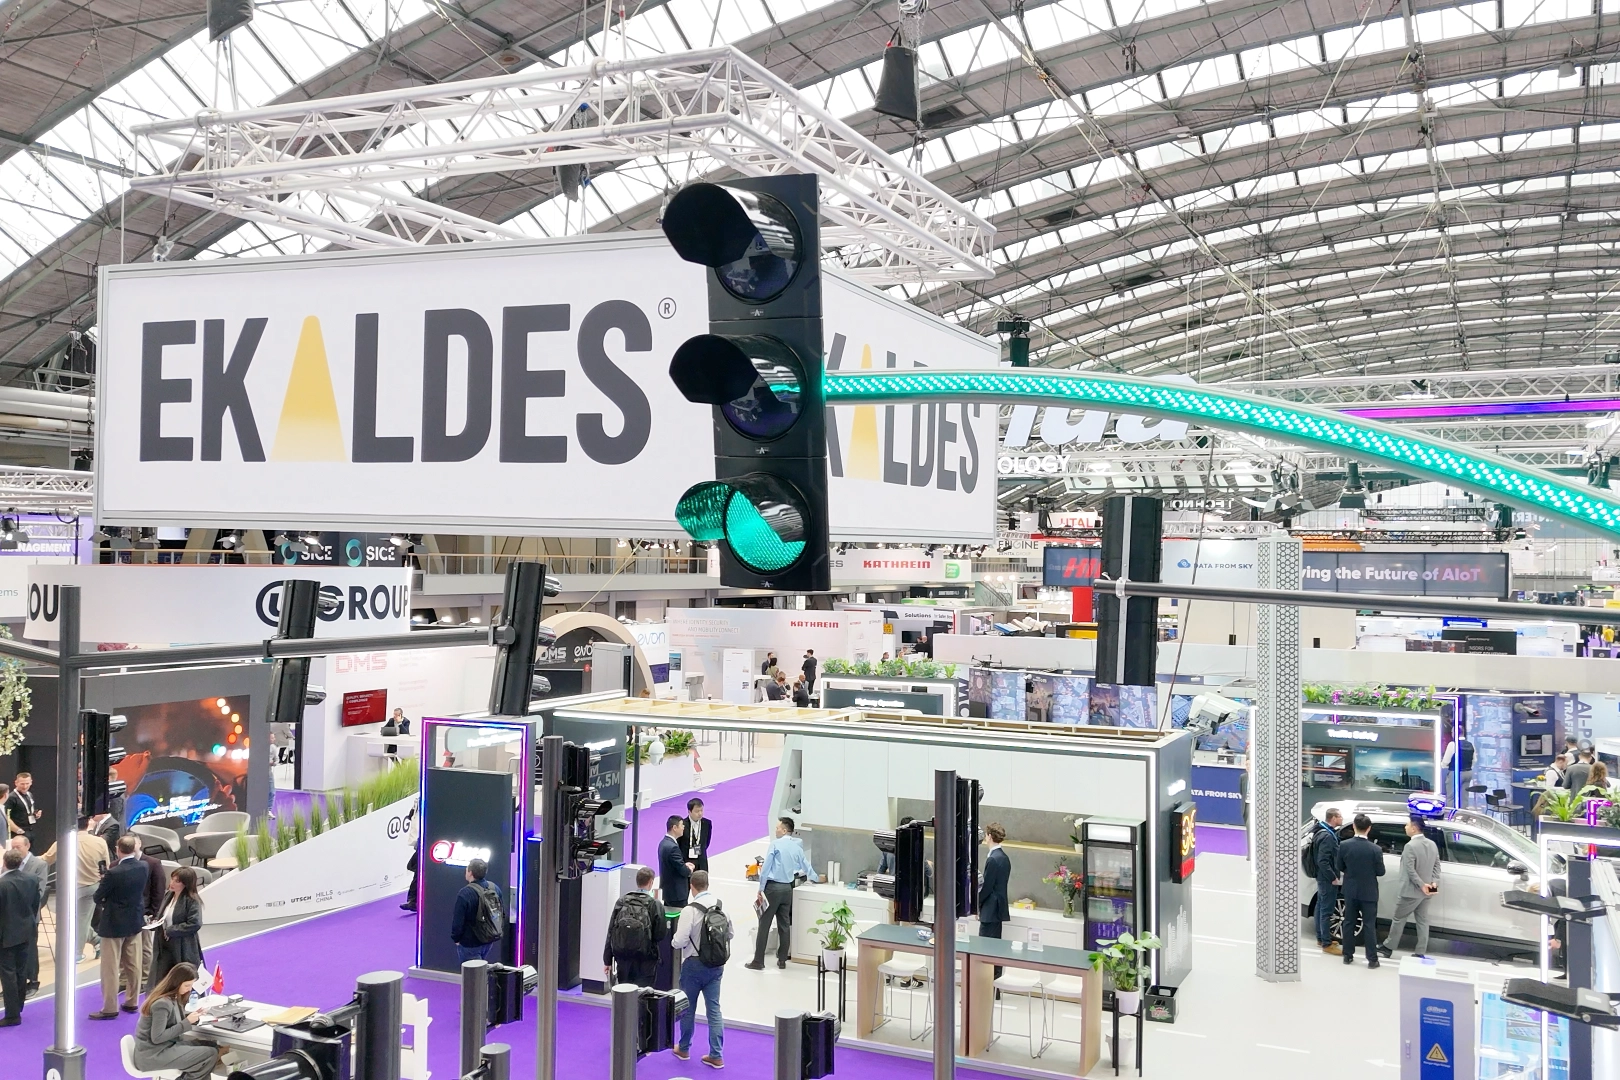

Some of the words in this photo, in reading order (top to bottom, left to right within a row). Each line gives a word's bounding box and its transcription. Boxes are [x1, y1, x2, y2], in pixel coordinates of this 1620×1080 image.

[365, 545, 396, 561] SICE
[863, 560, 931, 569] KATHREIN
[1334, 566, 1361, 580] the
[1365, 566, 1418, 581] Future
[1422, 567, 1439, 581] of
[790, 620, 839, 629] KATHREIN
[637, 631, 666, 646] evon
[335, 652, 388, 674] DMS
[1564, 699, 1574, 740] TRAFFI
[1190, 789, 1203, 798] ATA
[1204, 790, 1227, 798] FROM
[290, 895, 312, 903] UTSCH
[316, 889, 334, 898] HILLS
